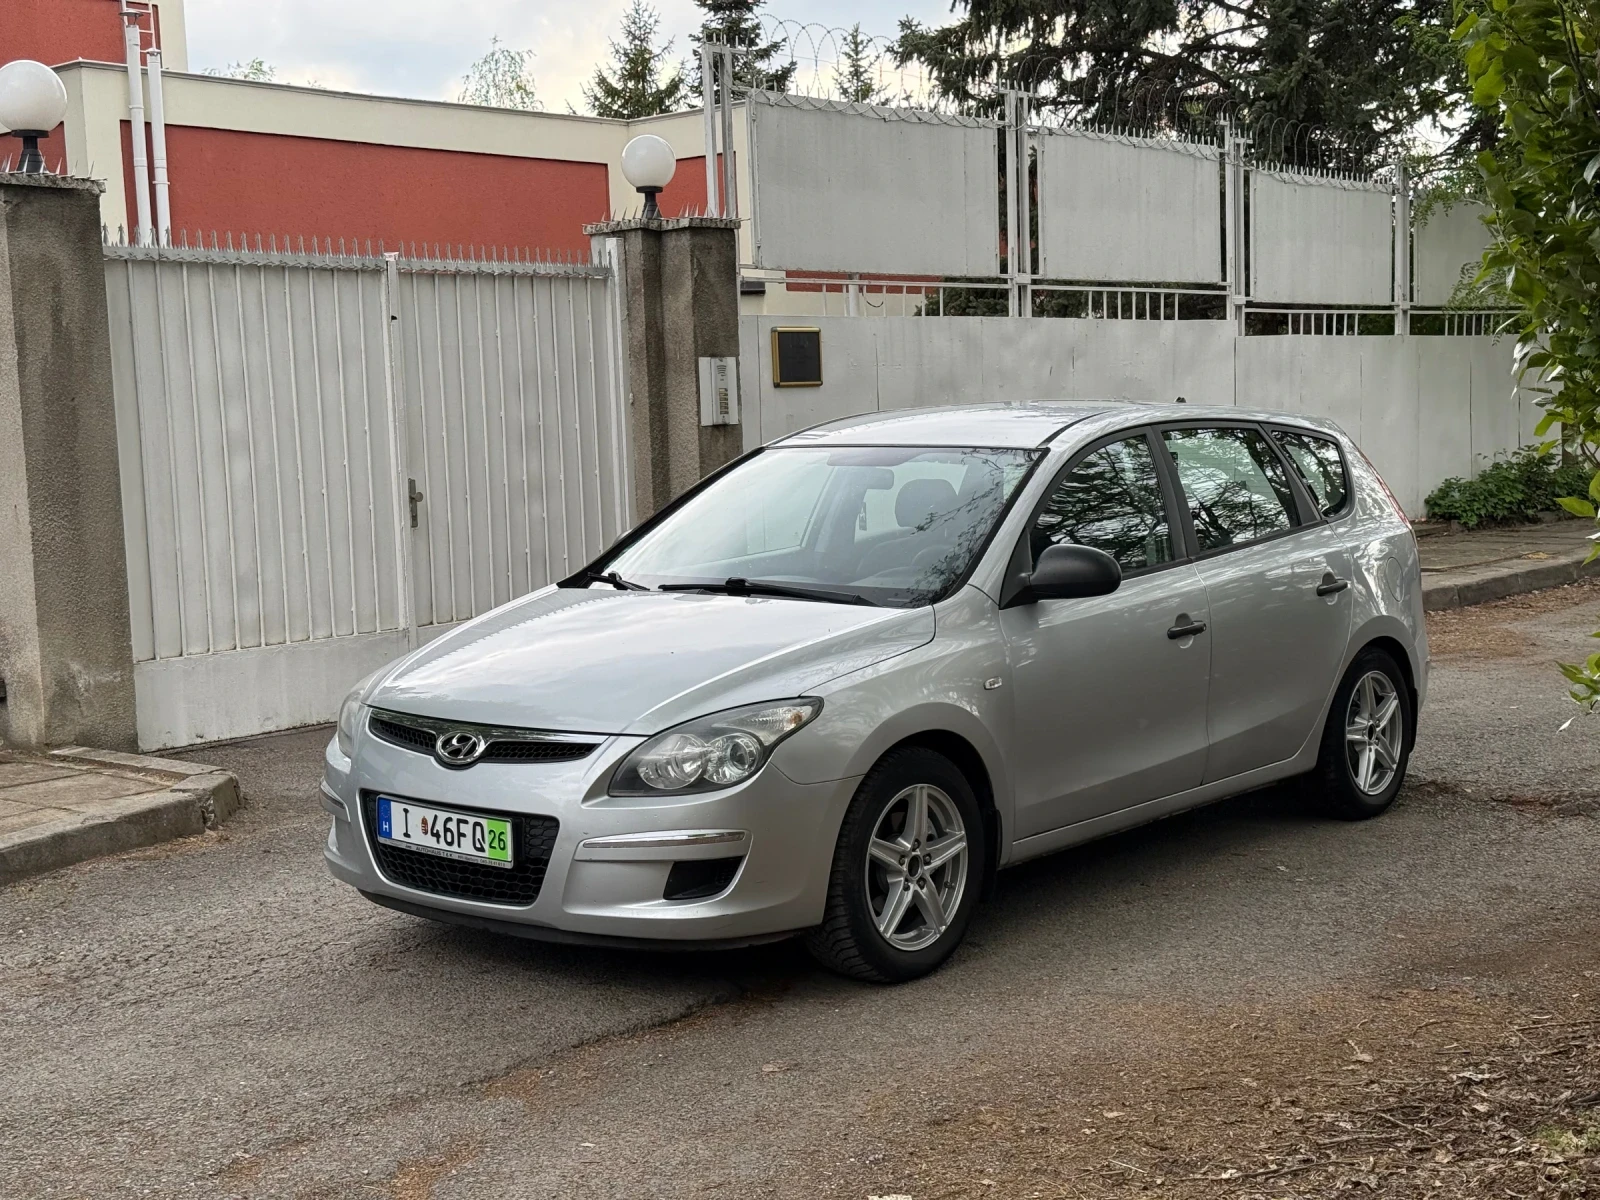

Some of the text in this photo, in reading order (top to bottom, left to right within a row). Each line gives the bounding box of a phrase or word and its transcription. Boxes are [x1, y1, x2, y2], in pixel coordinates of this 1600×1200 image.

[382, 821, 389, 833] H
[402, 807, 486, 853] I 46FQ
[488, 829, 506, 851] 26
